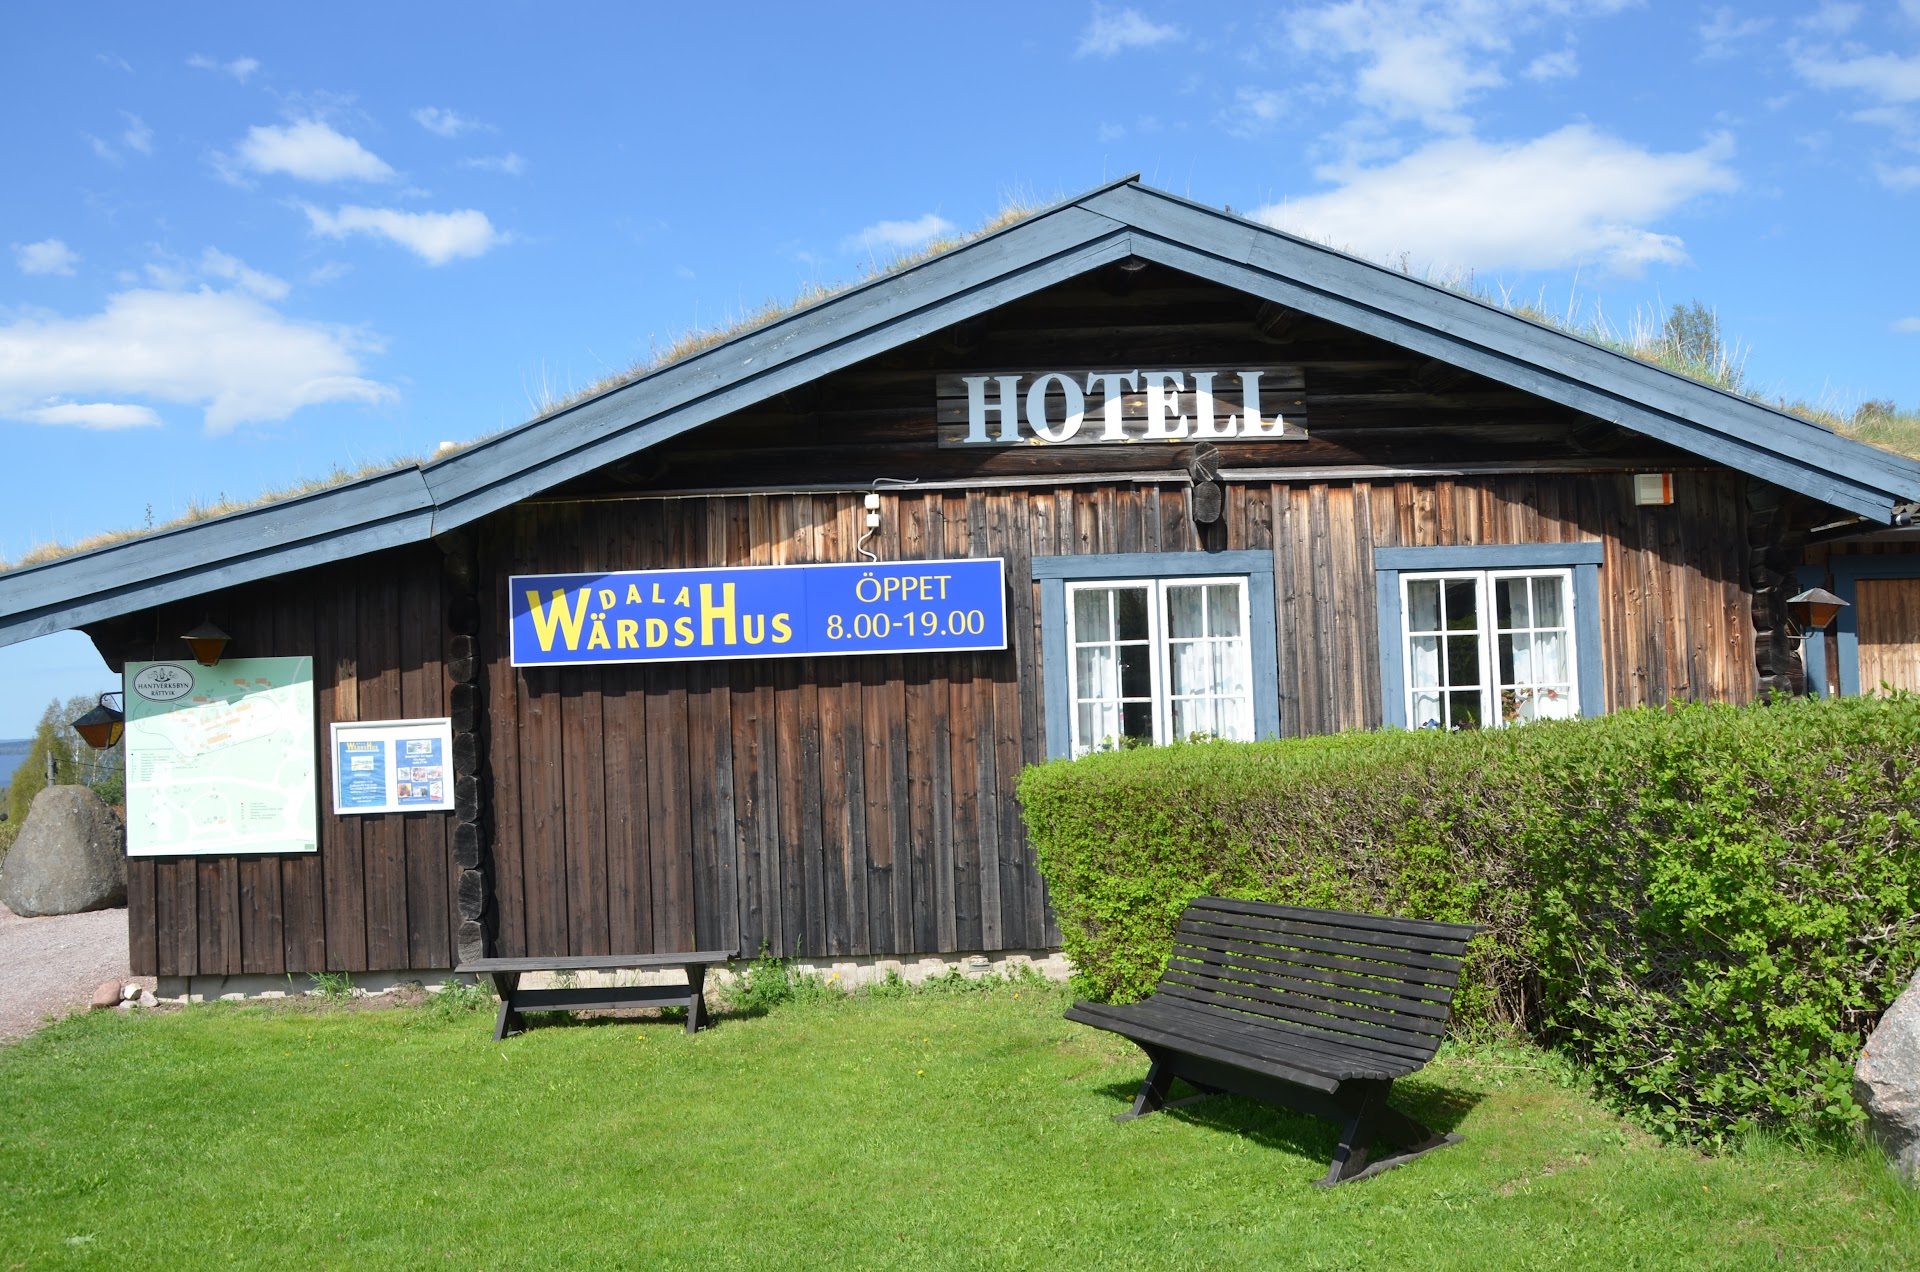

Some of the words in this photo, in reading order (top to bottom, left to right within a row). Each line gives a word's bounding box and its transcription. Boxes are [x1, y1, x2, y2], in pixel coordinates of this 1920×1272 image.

[961, 369, 1284, 443] HOTELL
[598, 582, 691, 611] DALA
[855, 572, 951, 602] ÖPPET
[826, 609, 985, 640] 8.00-19.00
